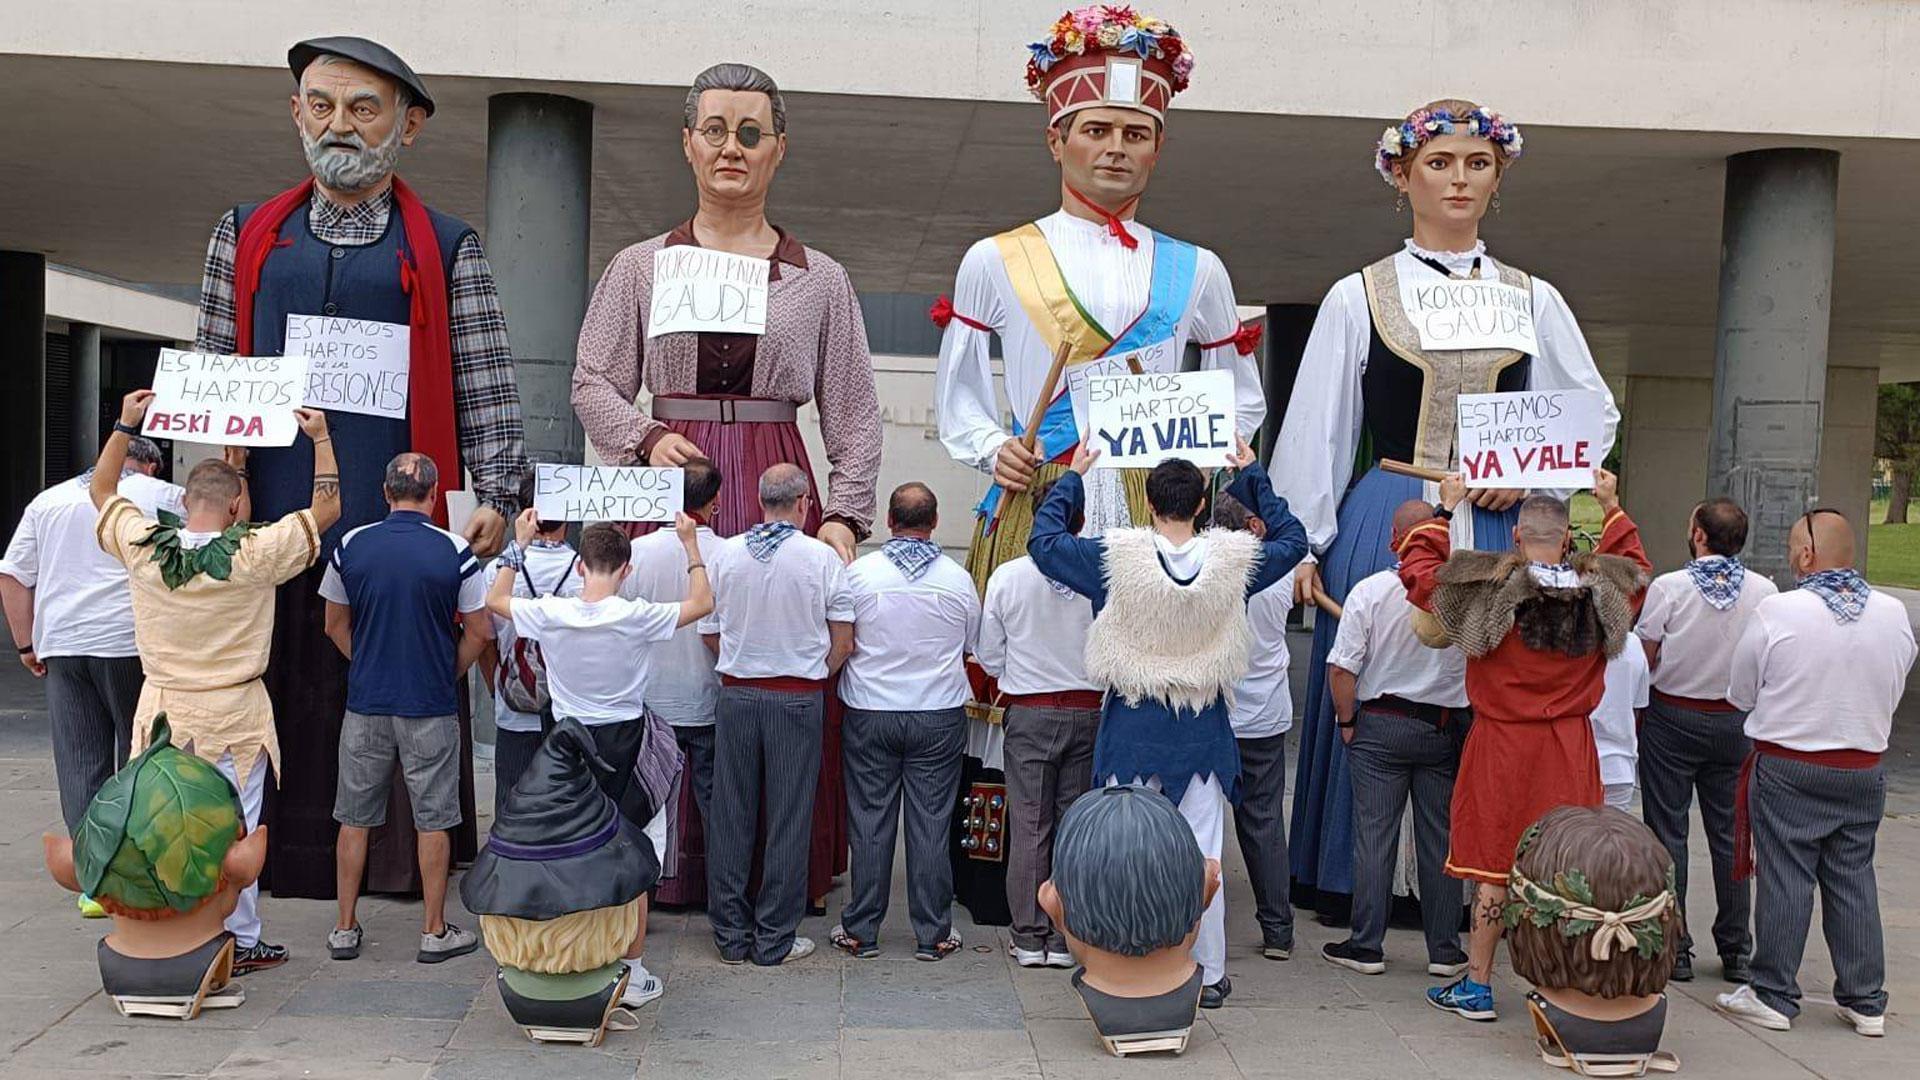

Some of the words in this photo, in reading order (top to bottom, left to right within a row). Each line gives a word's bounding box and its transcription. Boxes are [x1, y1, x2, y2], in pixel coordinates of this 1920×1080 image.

[653, 282, 765, 326] GAUDE
[287, 317, 394, 340] ESTAMOS
[1425, 309, 1531, 341] GAUDE
[160, 351, 280, 373] ESTAMOS
[303, 341, 378, 360] HARTOS
[180, 377, 295, 406] HARTOS
[1089, 375, 1181, 403] ESTAMOS
[1120, 393, 1210, 422] HARTOS
[1459, 394, 1563, 428] ESTAMOS
[225, 415, 264, 437] DA
[1098, 426, 1148, 457] YA
[1152, 414, 1229, 451] VALE
[1479, 426, 1546, 447] HARTOS
[1463, 449, 1504, 480] YA
[1512, 441, 1591, 474] VALE
[537, 465, 674, 495] ESTAMOS
[565, 495, 670, 520] HARTOS
